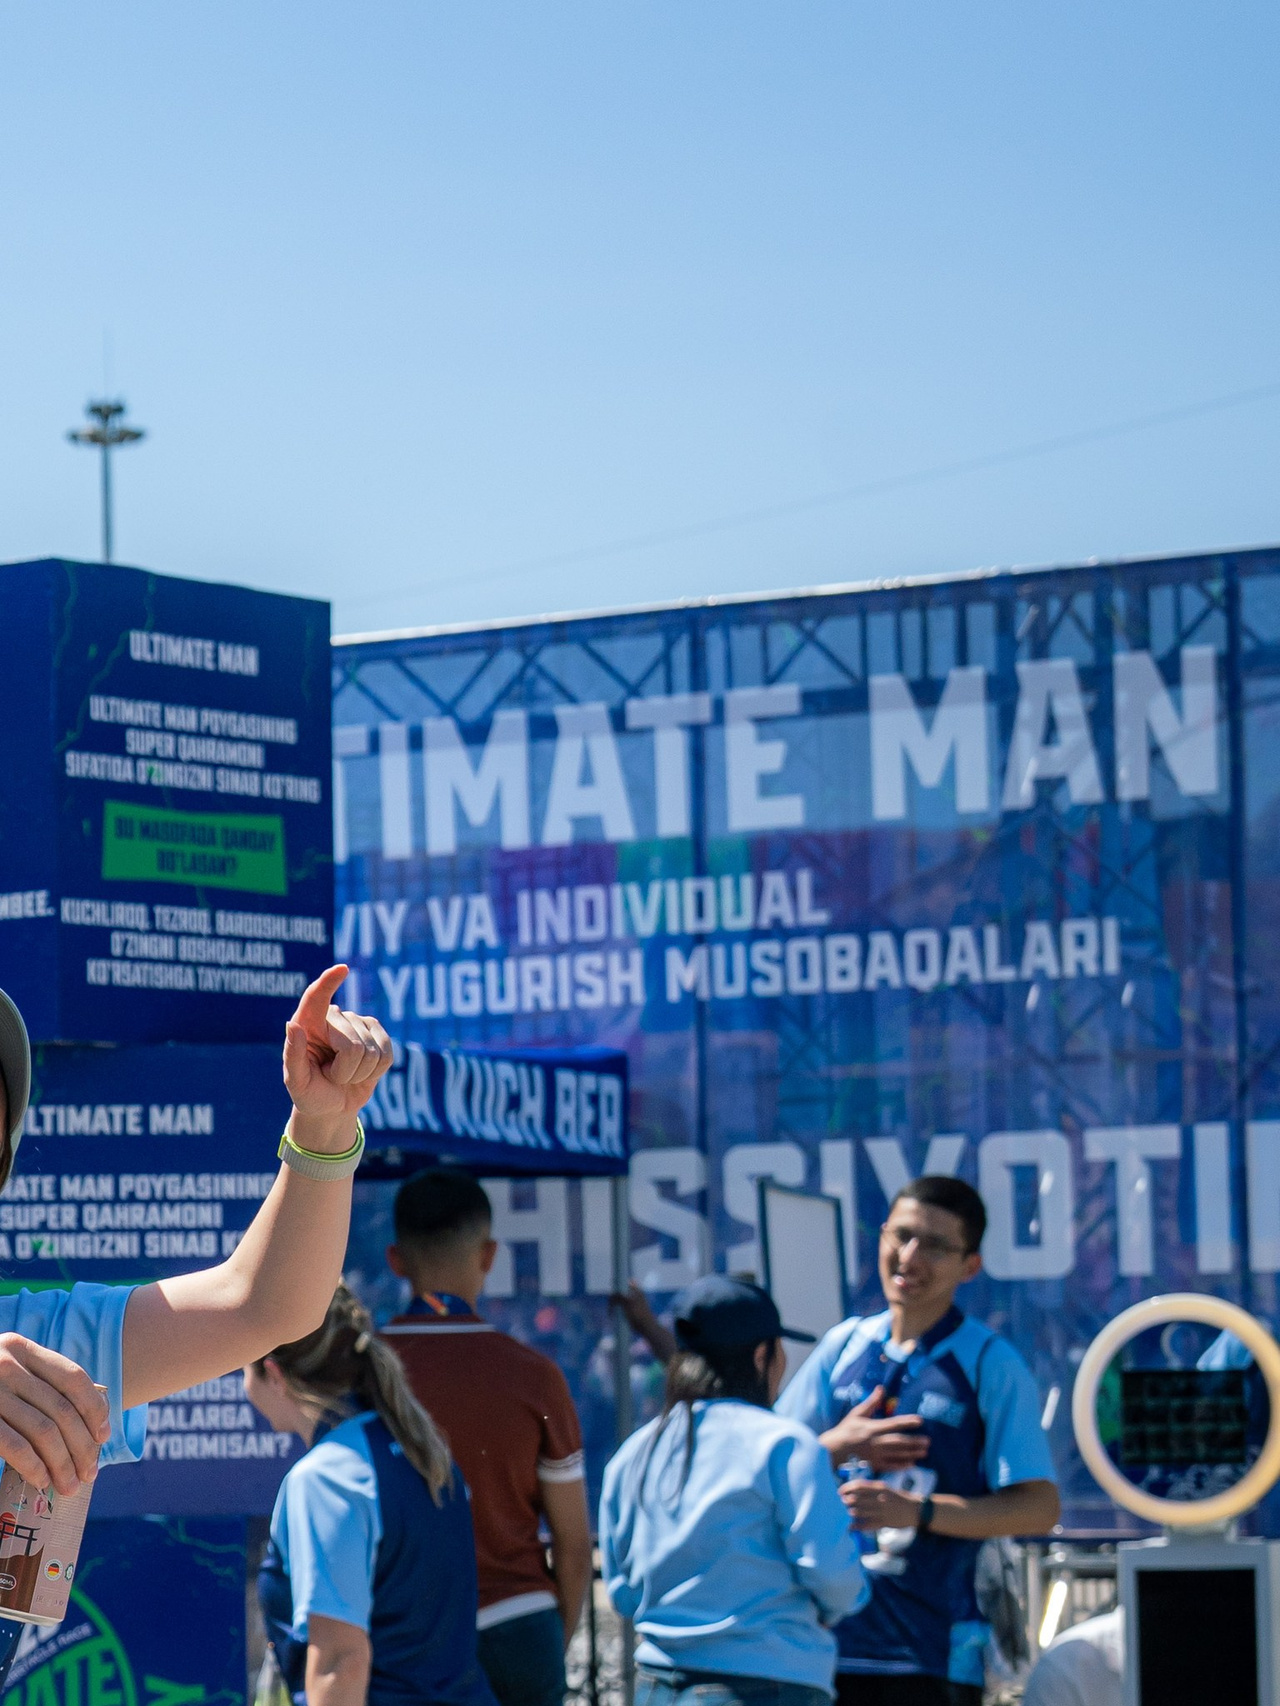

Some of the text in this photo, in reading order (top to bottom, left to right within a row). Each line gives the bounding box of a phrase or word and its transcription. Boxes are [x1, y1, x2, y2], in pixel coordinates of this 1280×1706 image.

[129, 629, 260, 677] ULTIMATE MAN
[89, 694, 162, 728] ULTIMATE
[164, 703, 199, 733] MAN
[125, 728, 177, 758] SUPER
[869, 646, 1220, 823] MAN
[427, 892, 500, 951] VA
[516, 868, 829, 947] INDIVIDUAL
[378, 944, 645, 1021] YUGURISH
[665, 916, 1120, 1003] MUSOBAQALARI
[21, 1104, 214, 1136] LTIMATE MAN
[441, 1049, 553, 1149] KUCH
[553, 1067, 626, 1159] BER
[60, 1174, 115, 1201] MAN
[81, 1203, 224, 1232] QAHRAMONI
[143, 1230, 218, 1258] SINAB
